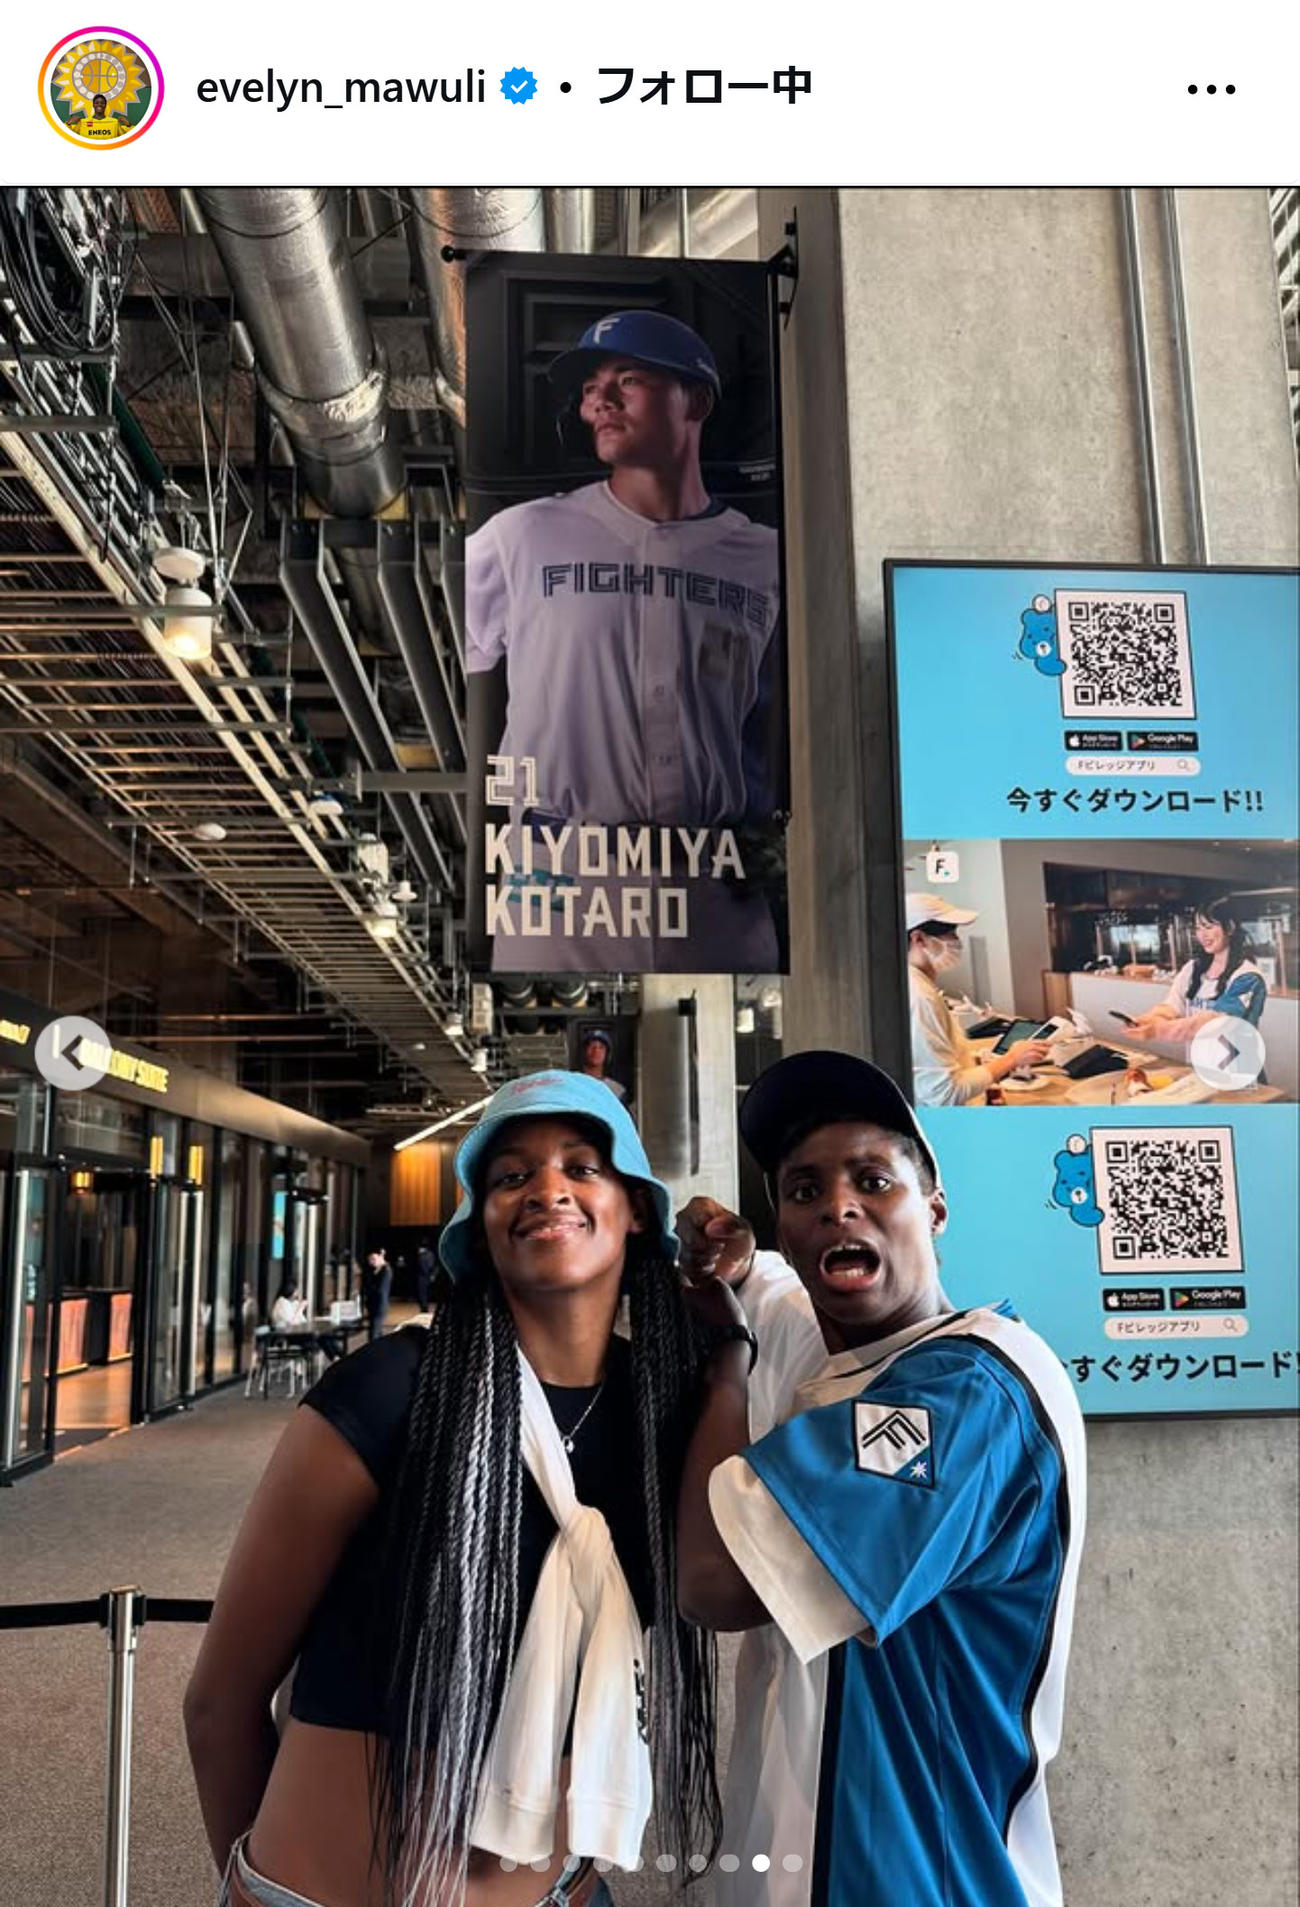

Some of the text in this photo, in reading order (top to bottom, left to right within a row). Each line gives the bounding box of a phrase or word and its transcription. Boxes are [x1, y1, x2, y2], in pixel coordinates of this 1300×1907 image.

[542, 562, 769, 627] FIGHTERS
[485, 754, 540, 807] 21
[485, 823, 746, 879] KIYOMIYA
[485, 884, 688, 938] KOTARO
